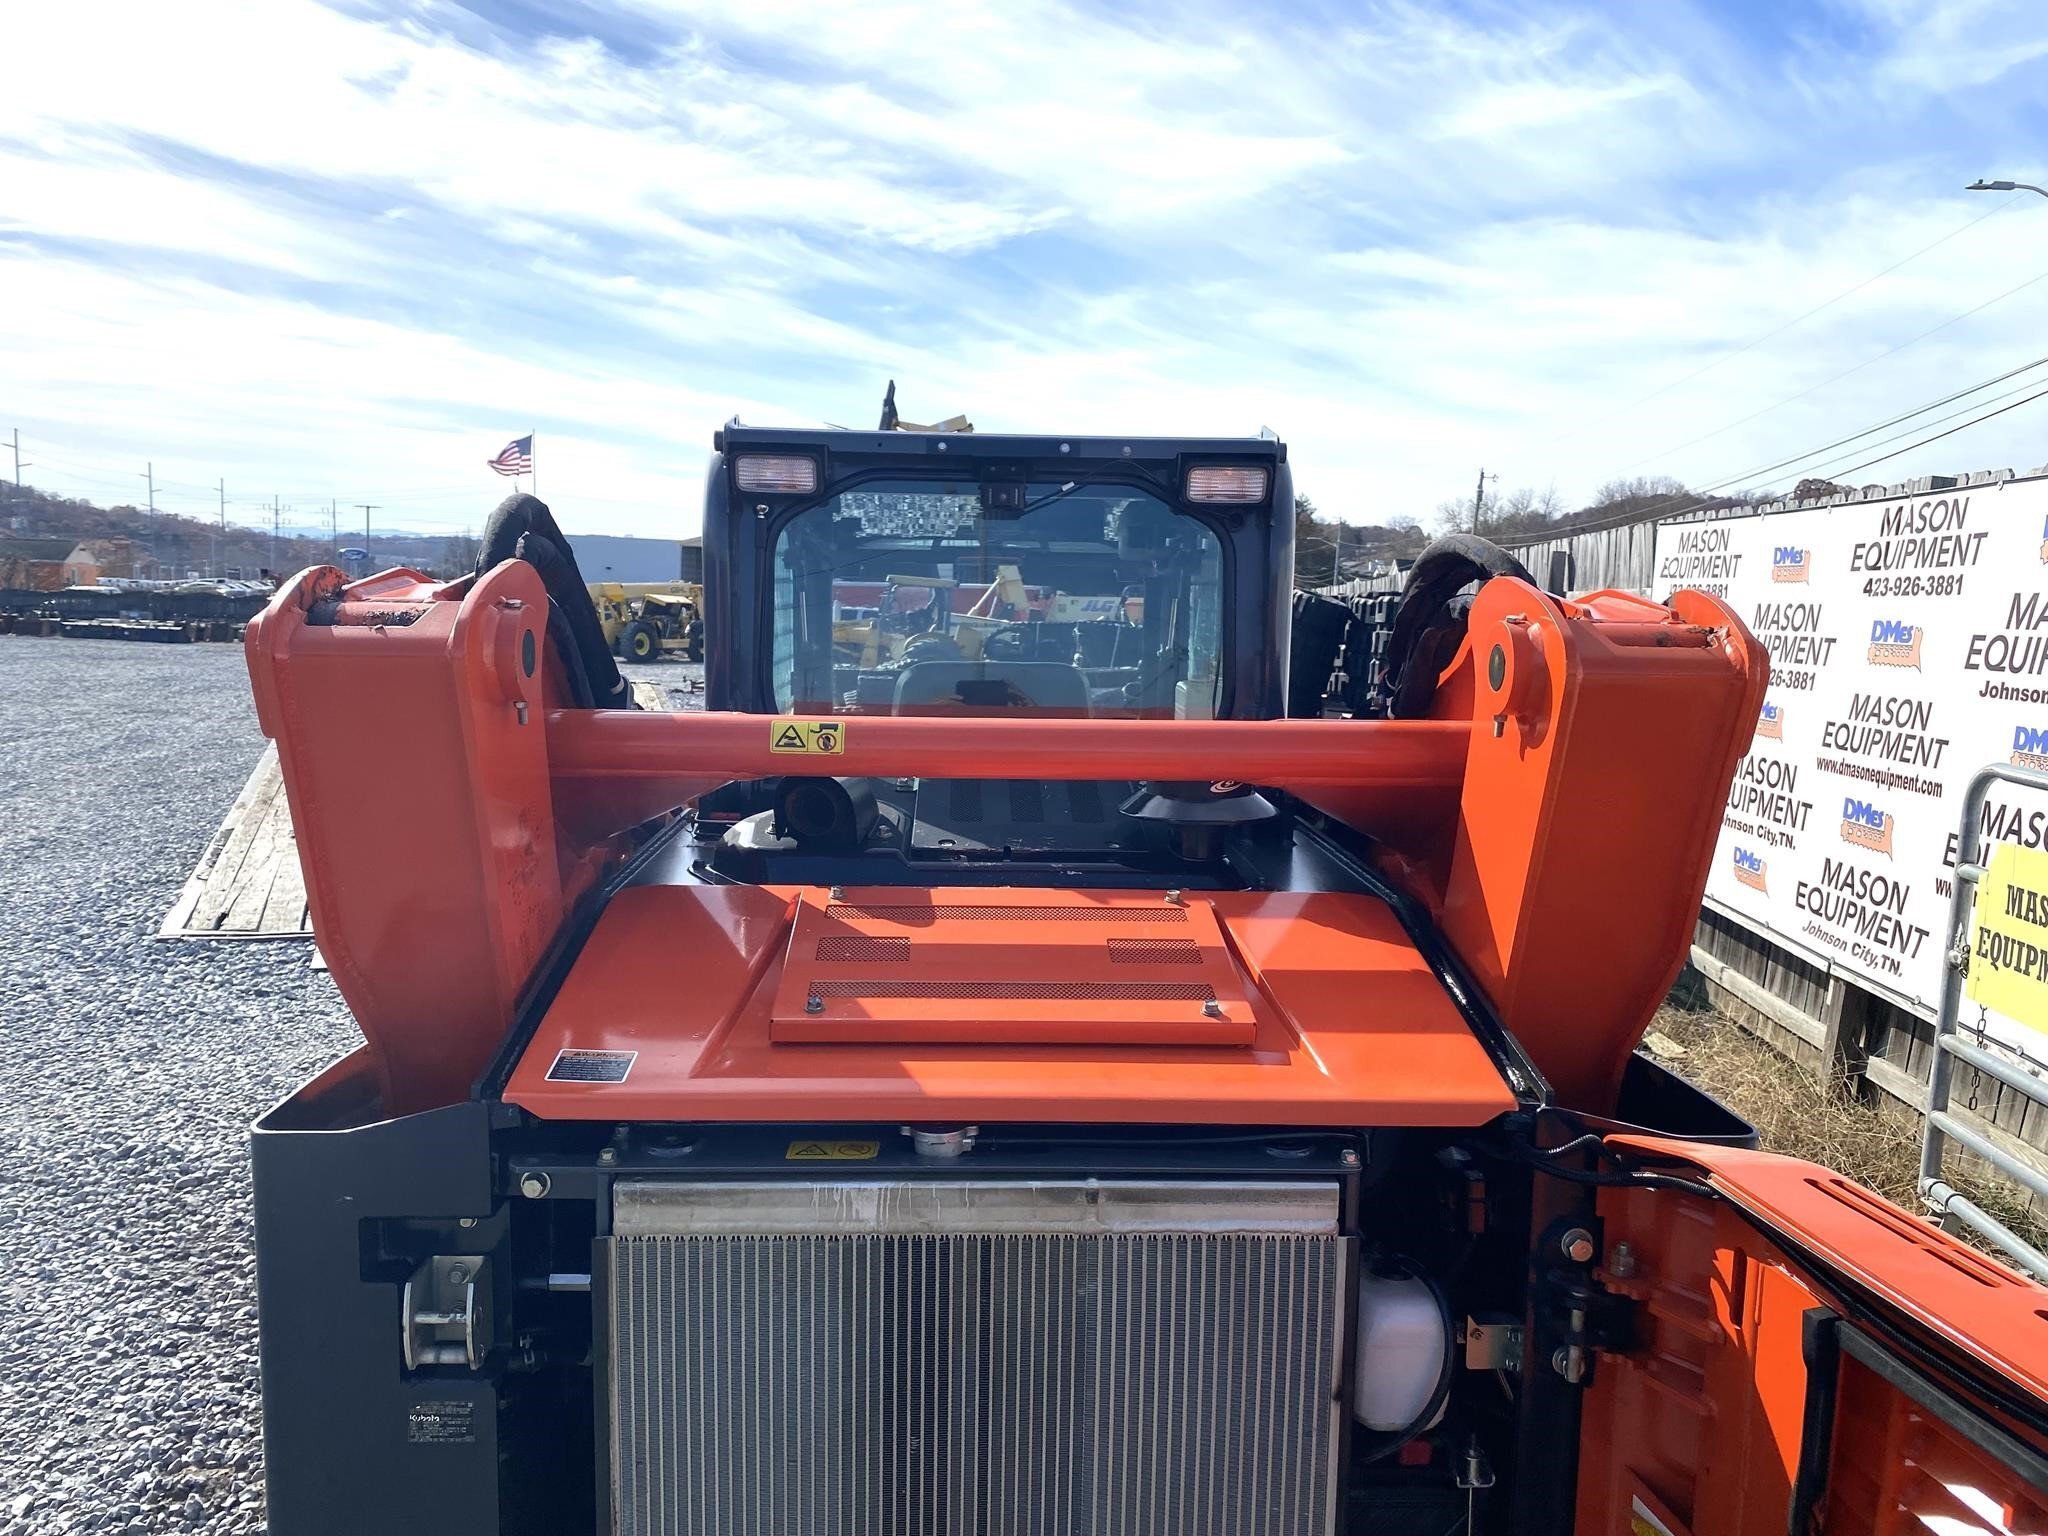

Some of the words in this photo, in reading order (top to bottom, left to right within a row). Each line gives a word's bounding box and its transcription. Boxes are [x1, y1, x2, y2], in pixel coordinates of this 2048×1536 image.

[1880, 497, 1970, 537] MASON
[1678, 528, 1731, 554] MASON
[1850, 532, 1989, 572] EQUIPMENT
[1659, 554, 1742, 579] EQUIPMENT
[1863, 574, 1964, 597] 423-926-3881
[1081, 600, 1115, 612] JLG
[1753, 603, 1822, 632] MASON
[1768, 668, 1816, 691] 26-3881
[1848, 693, 1933, 731] MASON
[1822, 721, 1949, 769] EQUIPMENT
[1817, 756, 1943, 798] www.dmasonequipment.com
[1724, 814, 1754, 835] hnson
[1727, 782, 1813, 831] UIPMENT
[1980, 800, 2048, 852] MAS
[1821, 857, 1910, 915] MASON
[1795, 880, 1930, 959] EQUIPMENT
[1802, 920, 1848, 952] Johnson
